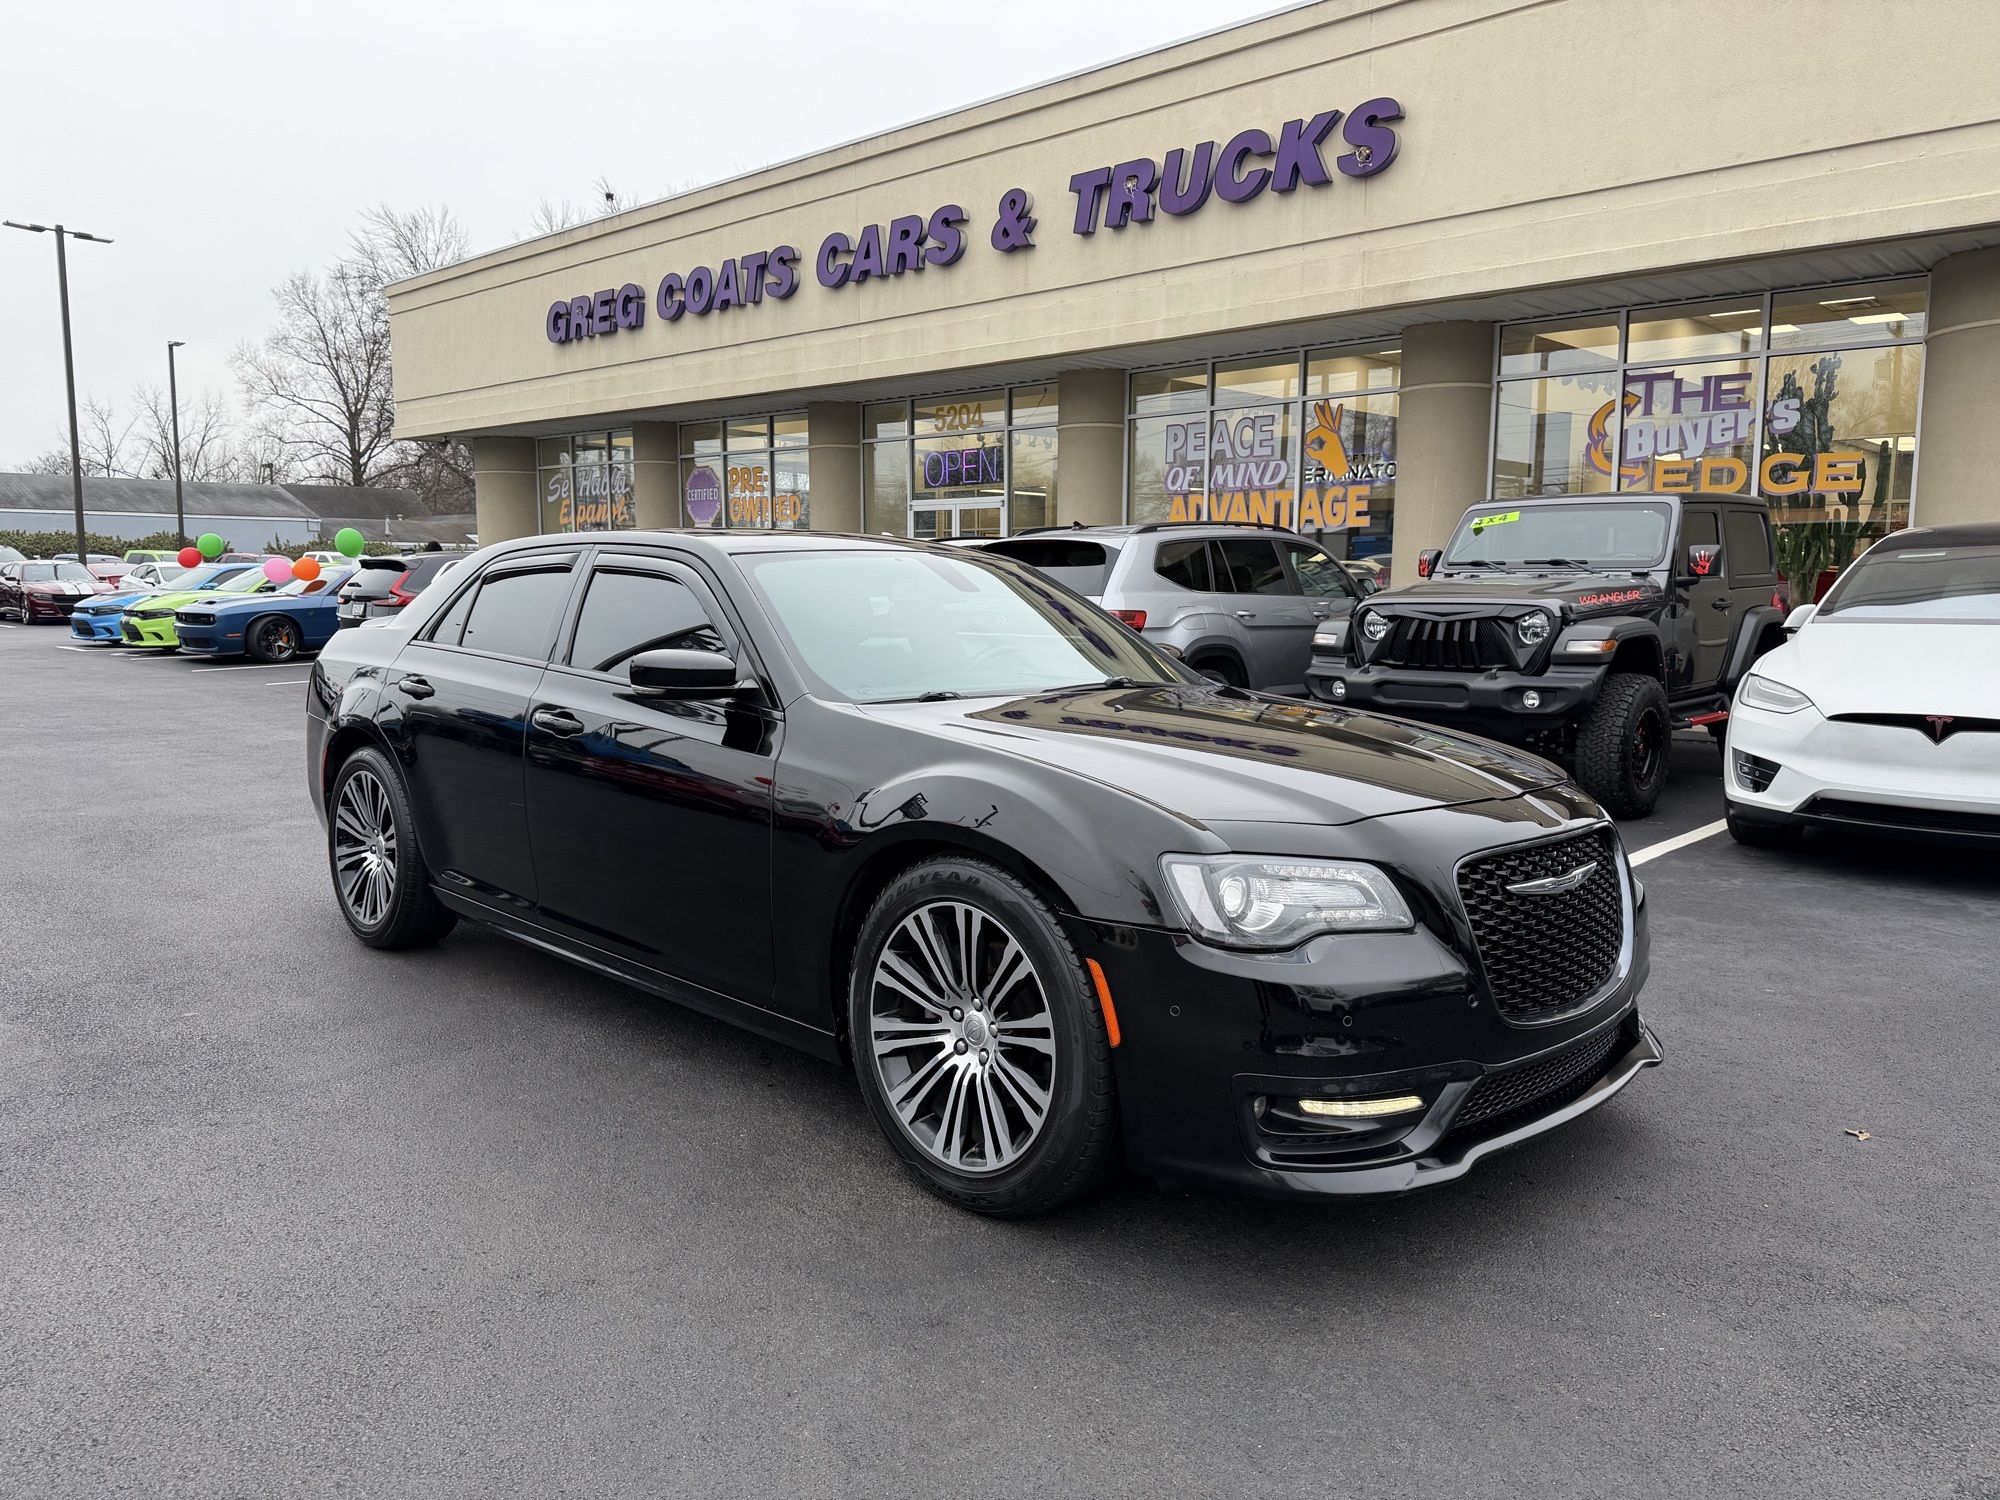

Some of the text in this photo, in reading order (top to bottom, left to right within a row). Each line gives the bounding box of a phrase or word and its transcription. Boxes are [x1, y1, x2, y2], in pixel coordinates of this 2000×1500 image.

[547, 97, 1406, 343] GREG COATS CARS & TRUCKS
[1626, 371, 1752, 417] THE
[934, 403, 984, 431] 5204
[1623, 398, 1801, 463] Buyer's
[1165, 415, 1275, 464] PEACE
[547, 465, 630, 502] Se Habla
[729, 466, 768, 493] PRE-
[925, 448, 997, 486] OPEN
[1165, 460, 1289, 492] OF MIND
[1652, 450, 1863, 495] EDGE
[687, 488, 719, 501] CERTIFIED
[729, 495, 800, 522] OWNED
[1167, 485, 1371, 529] ADVANTAGE
[559, 496, 630, 531] Epañl
[1579, 590, 1643, 606] WRANGLER
